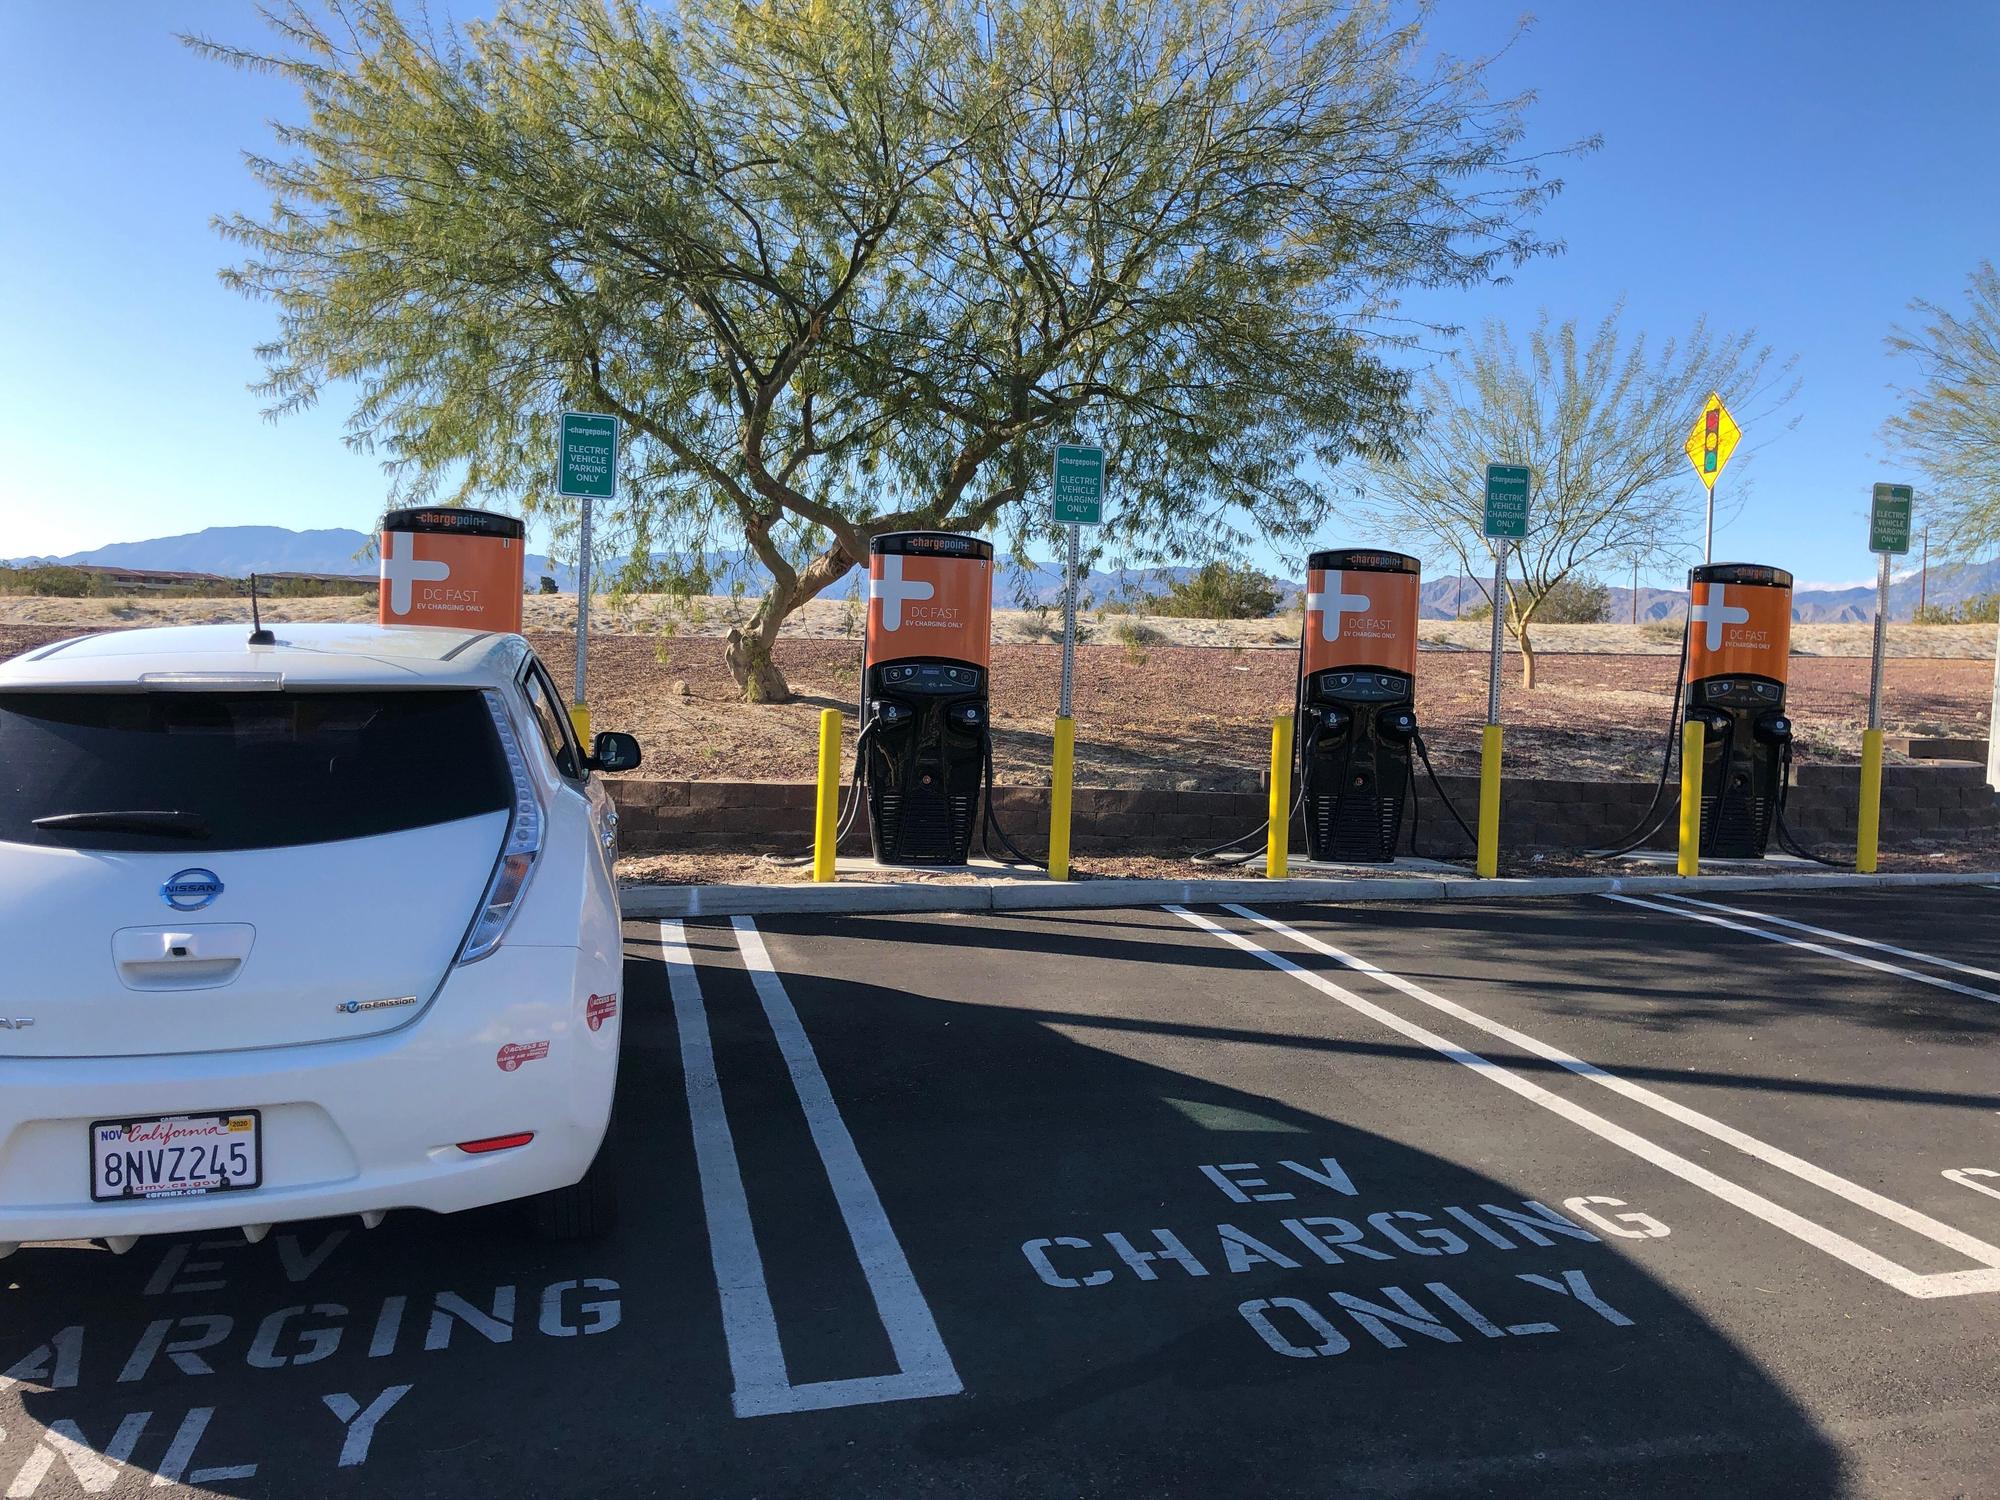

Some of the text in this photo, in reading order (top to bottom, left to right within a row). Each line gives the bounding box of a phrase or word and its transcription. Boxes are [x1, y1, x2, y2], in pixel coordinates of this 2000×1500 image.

[569, 445, 609, 455] ELECTRIC
[571, 454, 607, 465] VEHICLE
[569, 464, 607, 474] PARKING
[576, 474, 599, 483] ONLY
[1060, 476, 1098, 485] ELECTRIC
[1062, 486, 1095, 495] VEHICLE
[1057, 495, 1099, 505] CHARGING
[1490, 493, 1524, 502] ELECTRIC
[1067, 505, 1088, 513] ONLY
[1492, 502, 1522, 510] VEHICLE
[1488, 511, 1525, 520] CHARGING
[1876, 511, 1907, 520] ELECTRIC
[1496, 520, 1516, 528] ONLY
[1878, 519, 1905, 528] VEHICLE
[1874, 527, 1907, 537] CHARGING
[1881, 536, 1897, 544] ONLY
[423, 588, 479, 602] DC FAST
[428, 603, 464, 611] CHARGING
[911, 606, 960, 619] DC FAST
[947, 621, 964, 629] ONLY
[1349, 618, 1392, 630] DC FAST
[1730, 629, 1768, 641] DC FAST
[165, 884, 217, 893] NISSAN
[101, 1120, 248, 1146] NOV California 2020
[104, 1143, 248, 1187] 8NVZ245
[136, 1180, 219, 1191] dmv.ca.gov
[1200, 1158, 1358, 1203] EV
[145, 1188, 206, 1199] carmax.com
[1021, 1195, 1671, 1289] CHARGING
[144, 1230, 350, 1295] EV
[1236, 1269, 1635, 1359] ONLY
[0, 1384, 414, 1499] NLY
